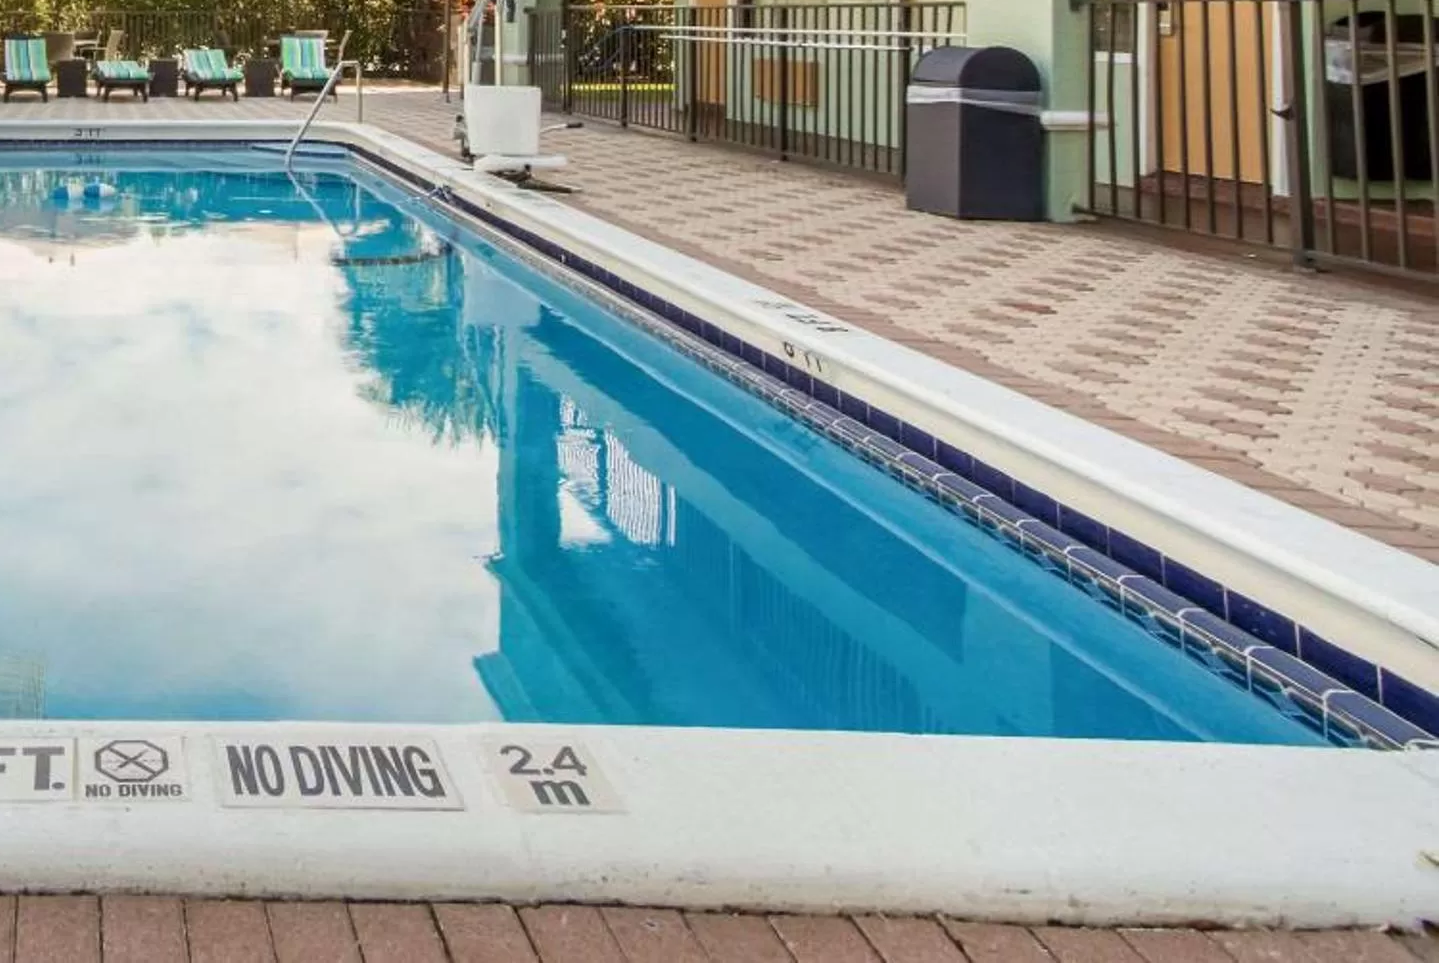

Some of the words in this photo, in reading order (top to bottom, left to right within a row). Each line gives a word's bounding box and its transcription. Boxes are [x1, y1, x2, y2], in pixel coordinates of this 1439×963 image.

[226, 744, 285, 796] NO
[289, 744, 446, 797] DIVING
[500, 745, 587, 776] 2.4
[85, 784, 111, 797] NO
[119, 784, 182, 797] DIVING
[529, 780, 590, 805] m
